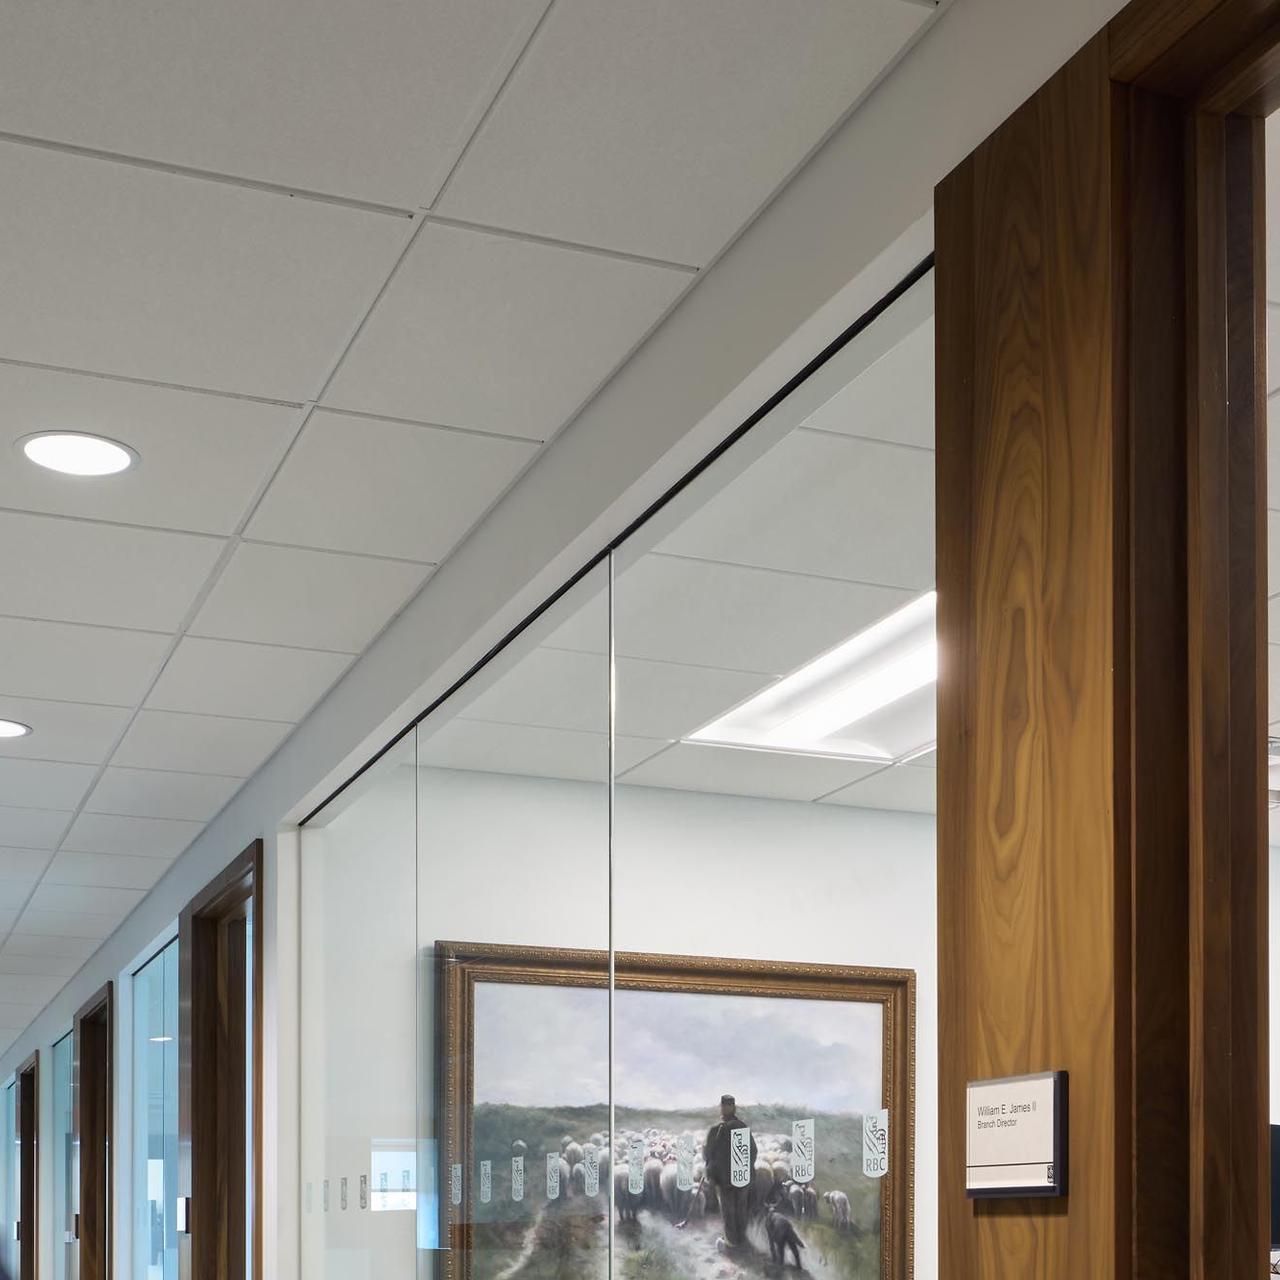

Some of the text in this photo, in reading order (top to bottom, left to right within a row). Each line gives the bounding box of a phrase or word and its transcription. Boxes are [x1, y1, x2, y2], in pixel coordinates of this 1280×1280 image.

[977, 1105, 1000, 1117] William
[1009, 1103, 1031, 1114] James
[977, 1118, 1017, 1129] Branch Director
[794, 1163, 813, 1178] RBC
[866, 1157, 886, 1172] RBC
[733, 1169, 748, 1183] RBC
